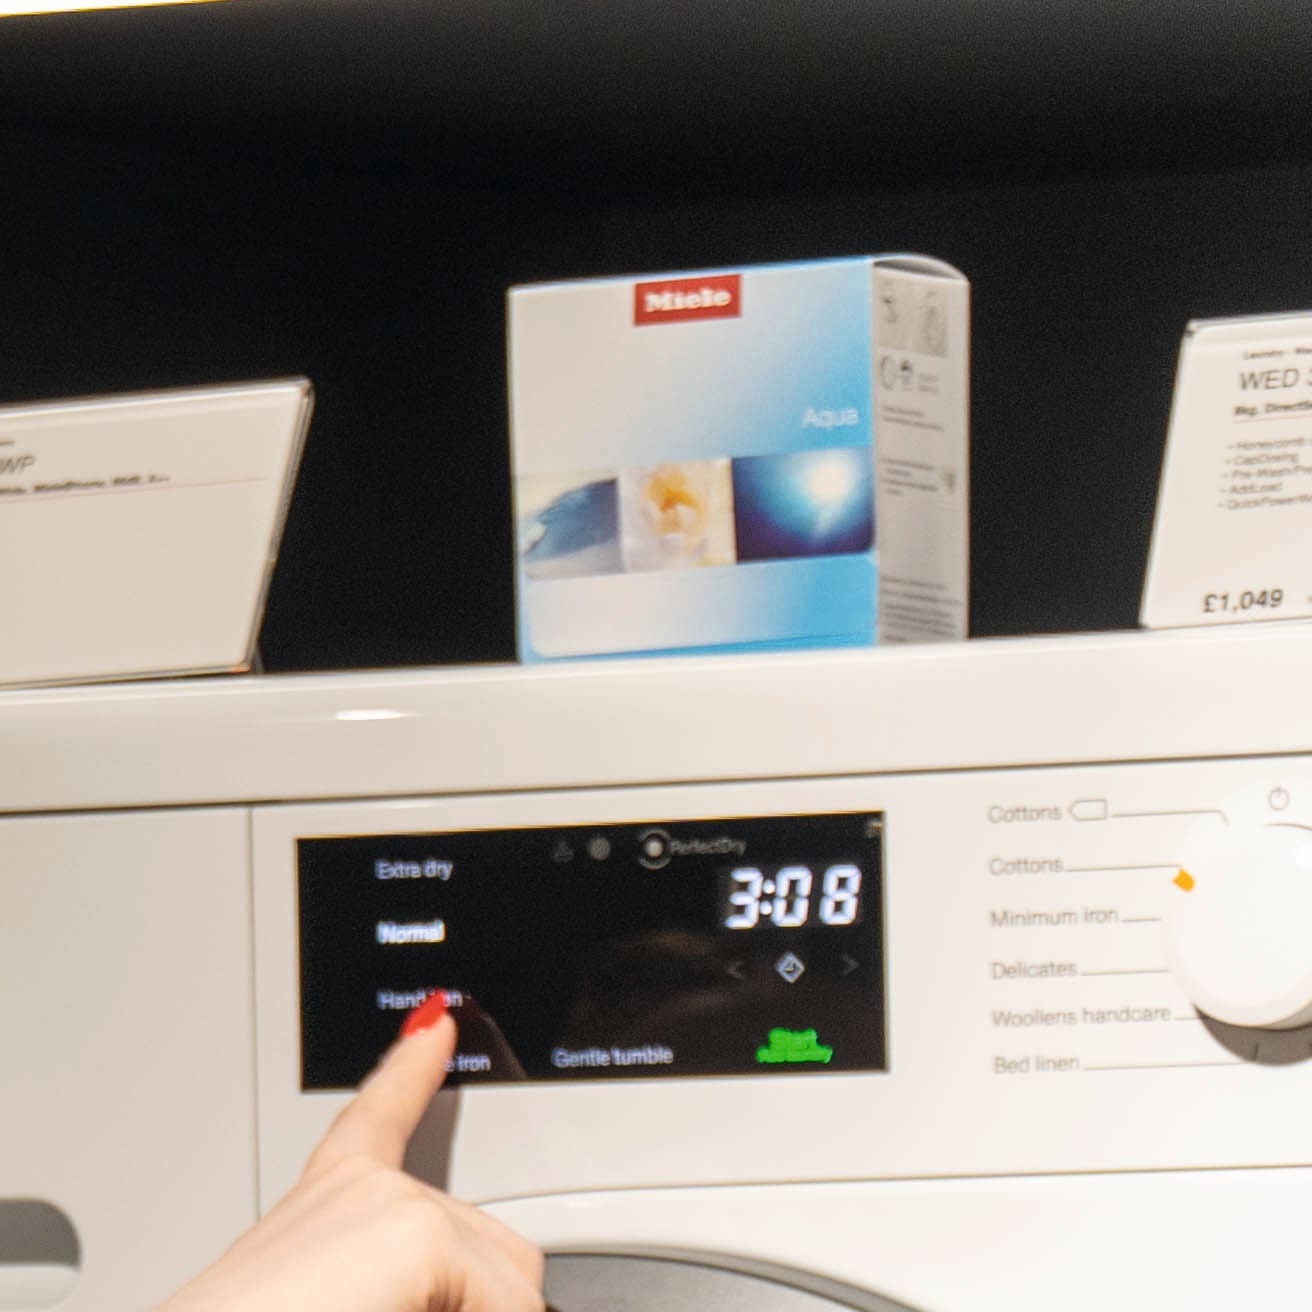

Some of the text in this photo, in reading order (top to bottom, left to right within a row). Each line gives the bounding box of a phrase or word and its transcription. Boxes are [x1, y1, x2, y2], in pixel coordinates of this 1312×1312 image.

[644, 287, 731, 312] Miele
[1239, 368, 1300, 390] WED
[800, 406, 859, 431] Aqua
[1203, 589, 1283, 612] £1,049
[986, 804, 1063, 824] Cottons
[375, 858, 454, 880] Extra dry
[988, 856, 1064, 876] Cottons
[726, 864, 862, 929] 3:08
[990, 906, 1120, 927] Minimum iron
[377, 919, 446, 944] Normal
[992, 961, 1078, 980] Delicates
[992, 1005, 1172, 1028] Woollens handcare
[551, 1045, 674, 1068] Gentle tumble
[993, 1054, 1080, 1074] Bed linen
